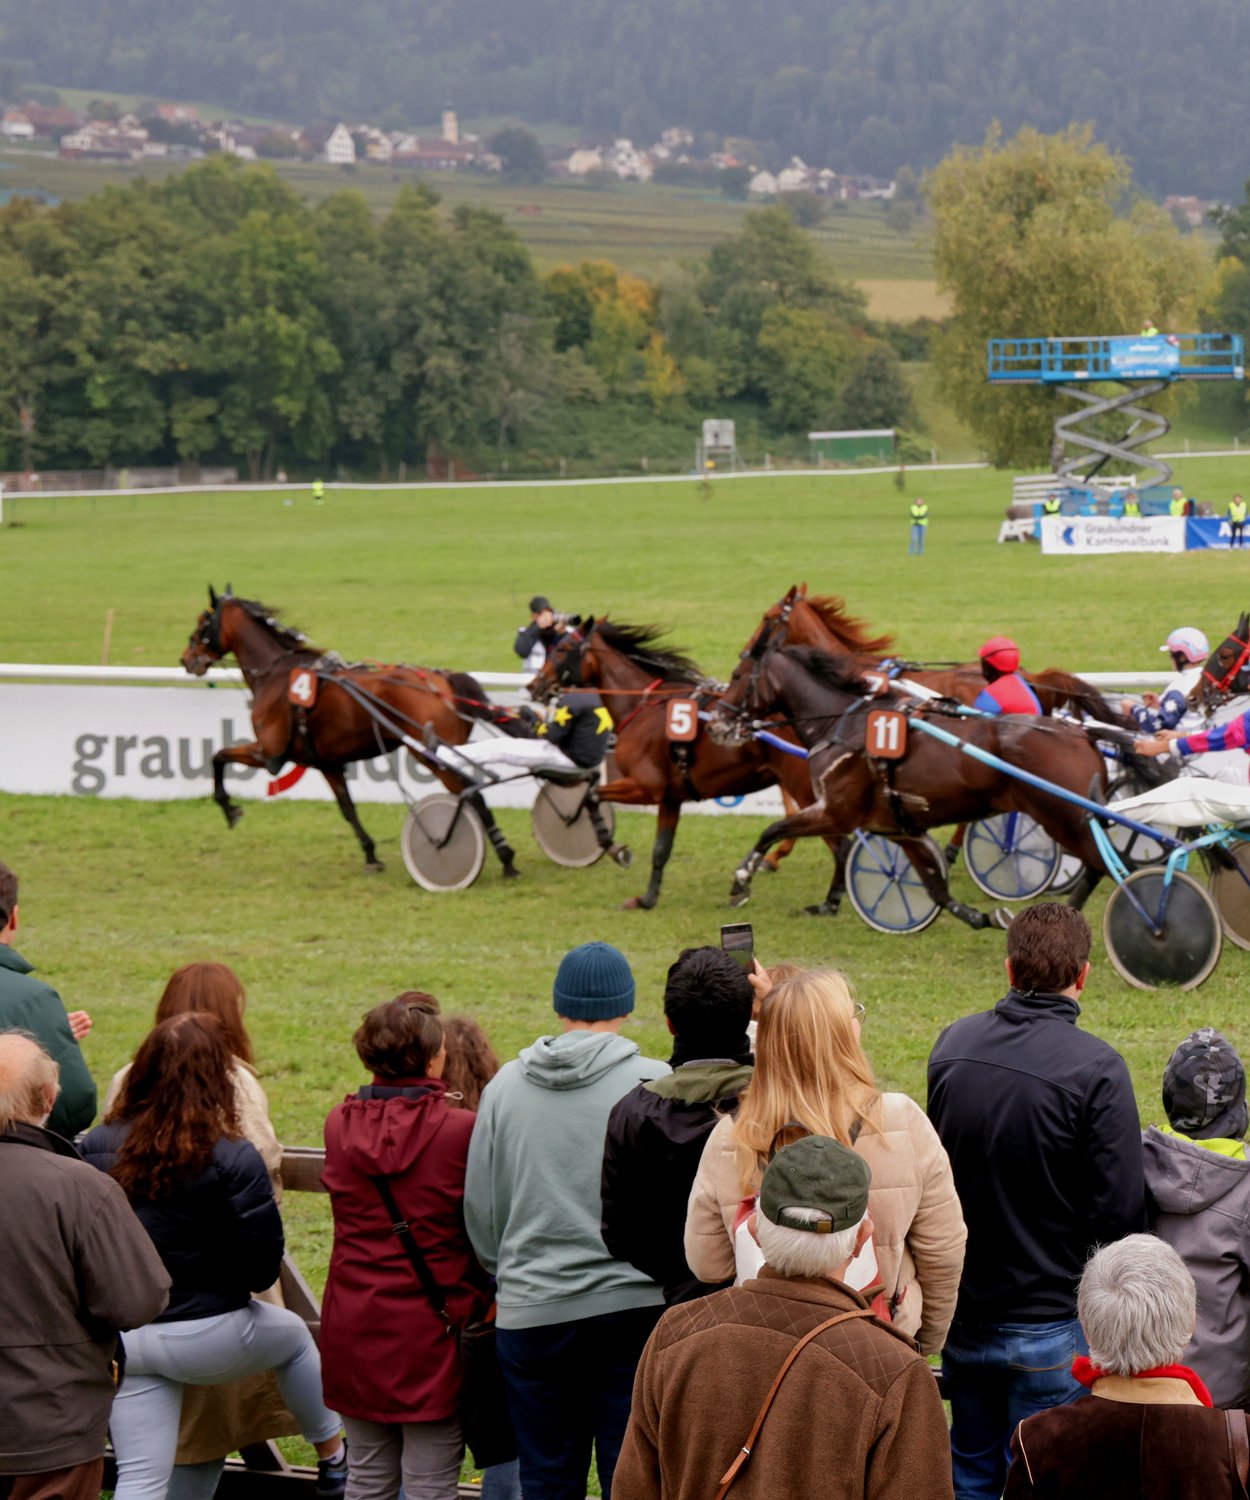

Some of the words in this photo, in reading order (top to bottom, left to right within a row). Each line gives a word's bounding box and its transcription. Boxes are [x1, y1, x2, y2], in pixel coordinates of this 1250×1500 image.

[1084, 524, 1151, 534] Graubündner
[1085, 535, 1170, 547] Kantonalbank
[291, 673, 311, 701] 4
[864, 675, 884, 700] 7
[671, 703, 692, 735] 5
[873, 715, 899, 751] 11
